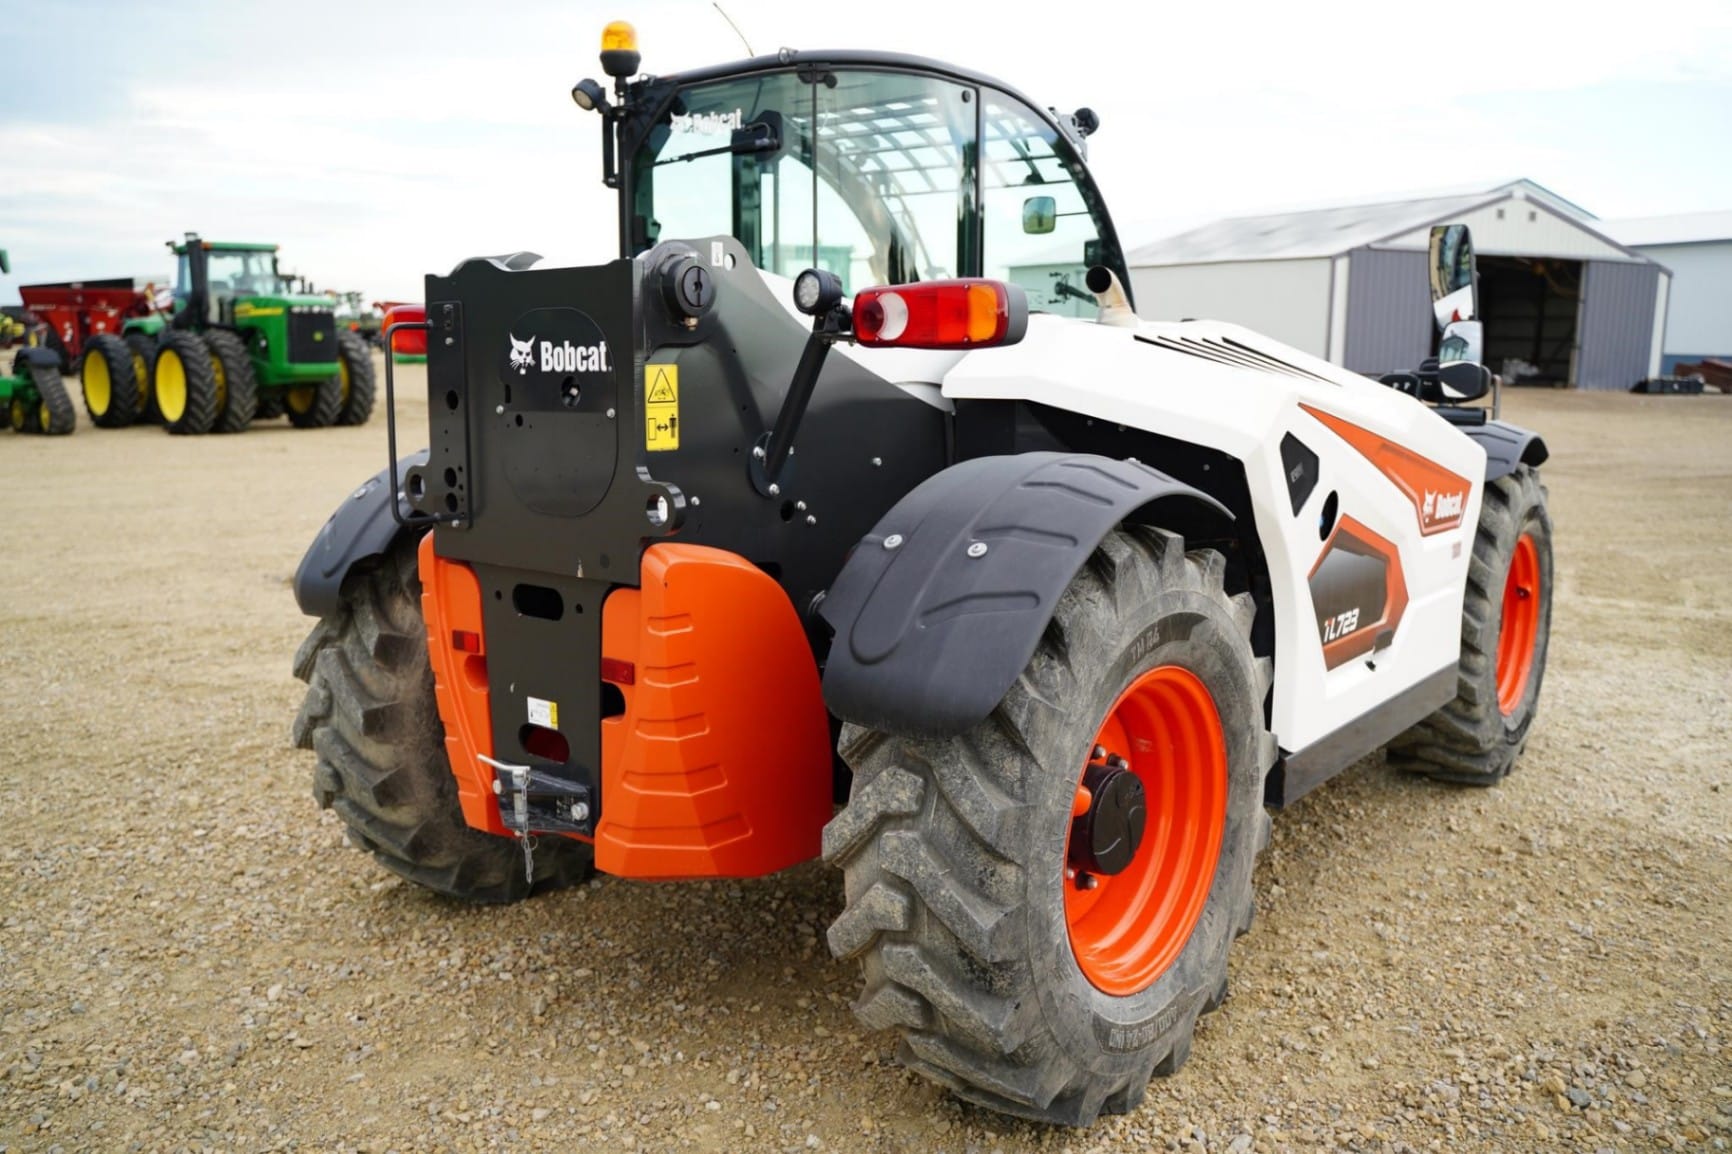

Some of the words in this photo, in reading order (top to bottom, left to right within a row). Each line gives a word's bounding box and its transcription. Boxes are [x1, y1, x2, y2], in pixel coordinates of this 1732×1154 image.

[692, 108, 741, 134] Bobcat
[540, 340, 608, 373] Bobcat
[1324, 607, 1360, 643] TL723
